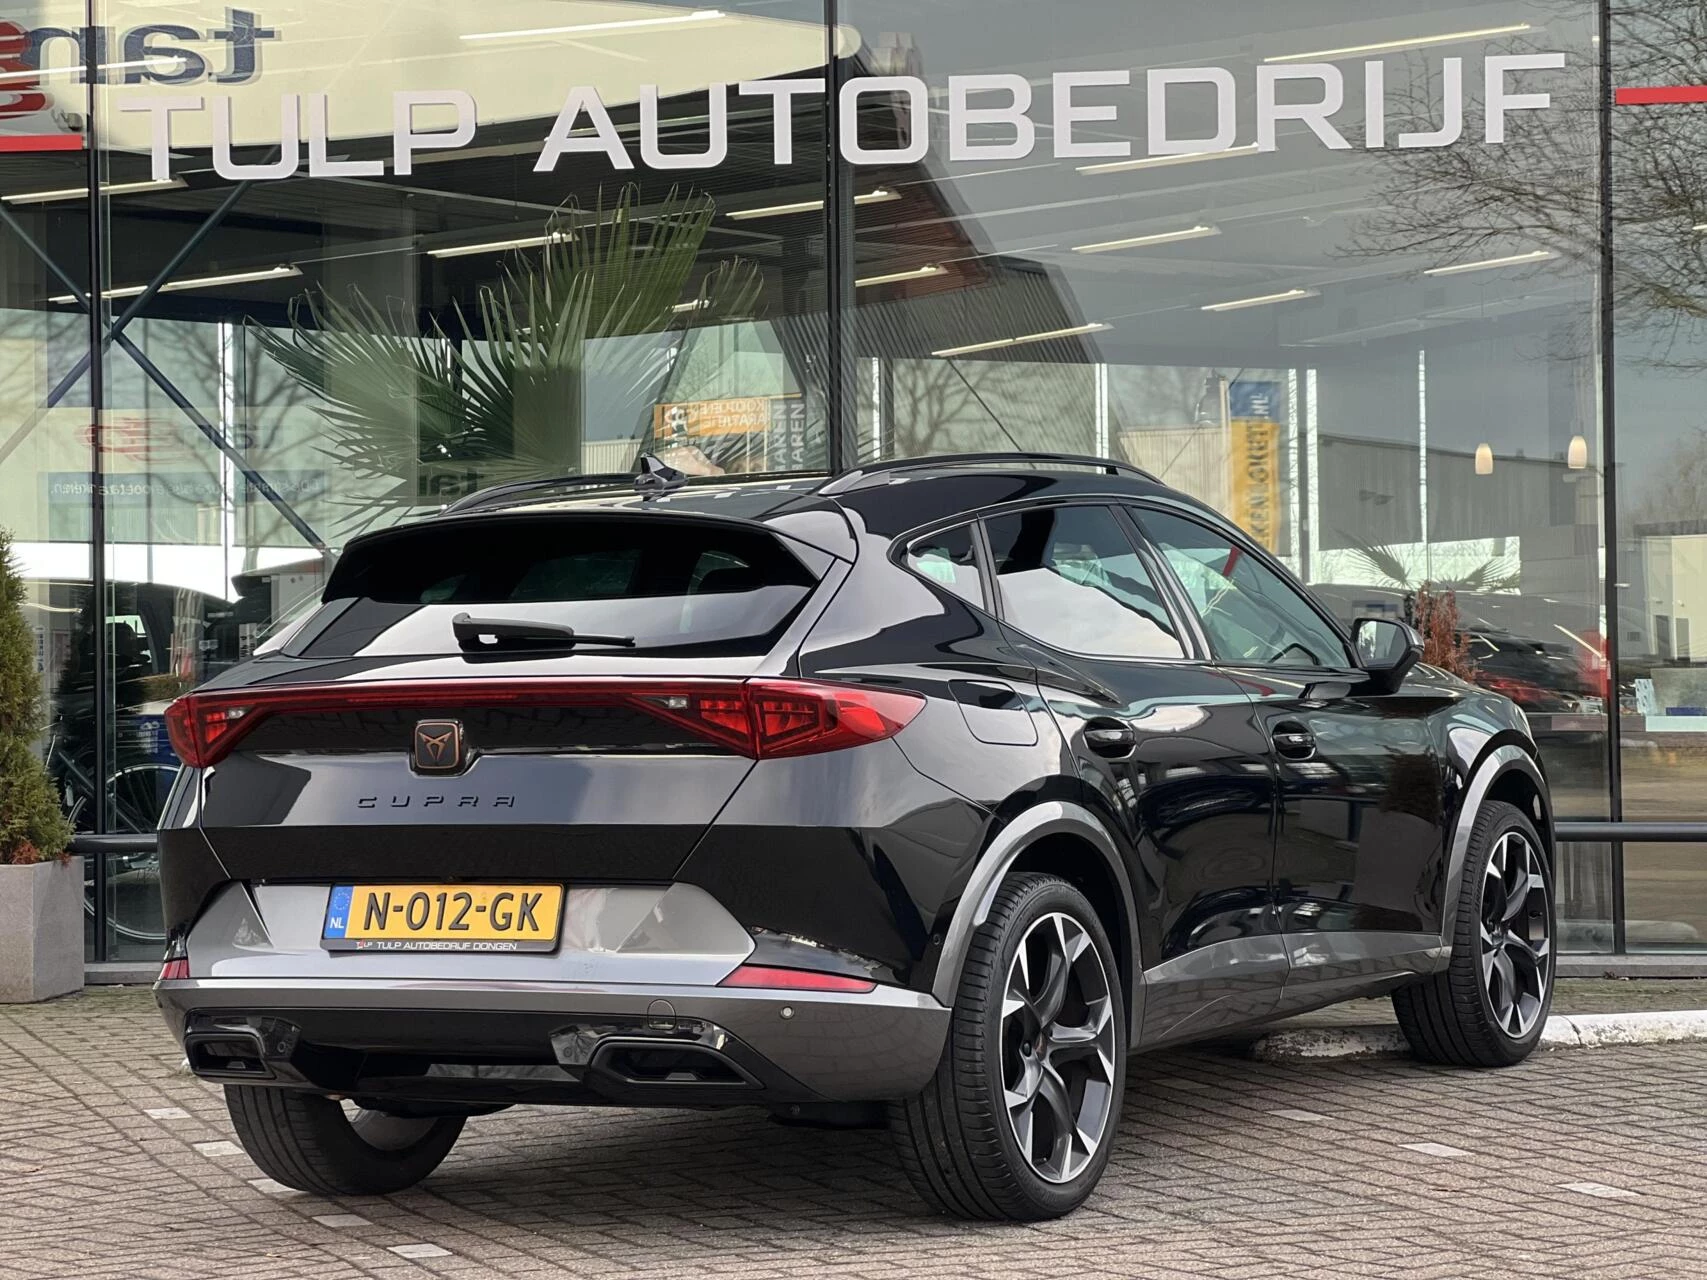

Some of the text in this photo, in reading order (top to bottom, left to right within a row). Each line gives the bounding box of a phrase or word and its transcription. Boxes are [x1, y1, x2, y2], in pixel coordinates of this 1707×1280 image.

[118, 52, 1566, 182] TULP AUTOBEDRIJF
[357, 795, 515, 809] CUPRA
[363, 891, 543, 932] N-012-GK
[329, 916, 345, 930] NL
[377, 941, 402, 950] TULP
[403, 941, 472, 951] AUTOBEDRIJF
[472, 942, 518, 951] DONGEN
